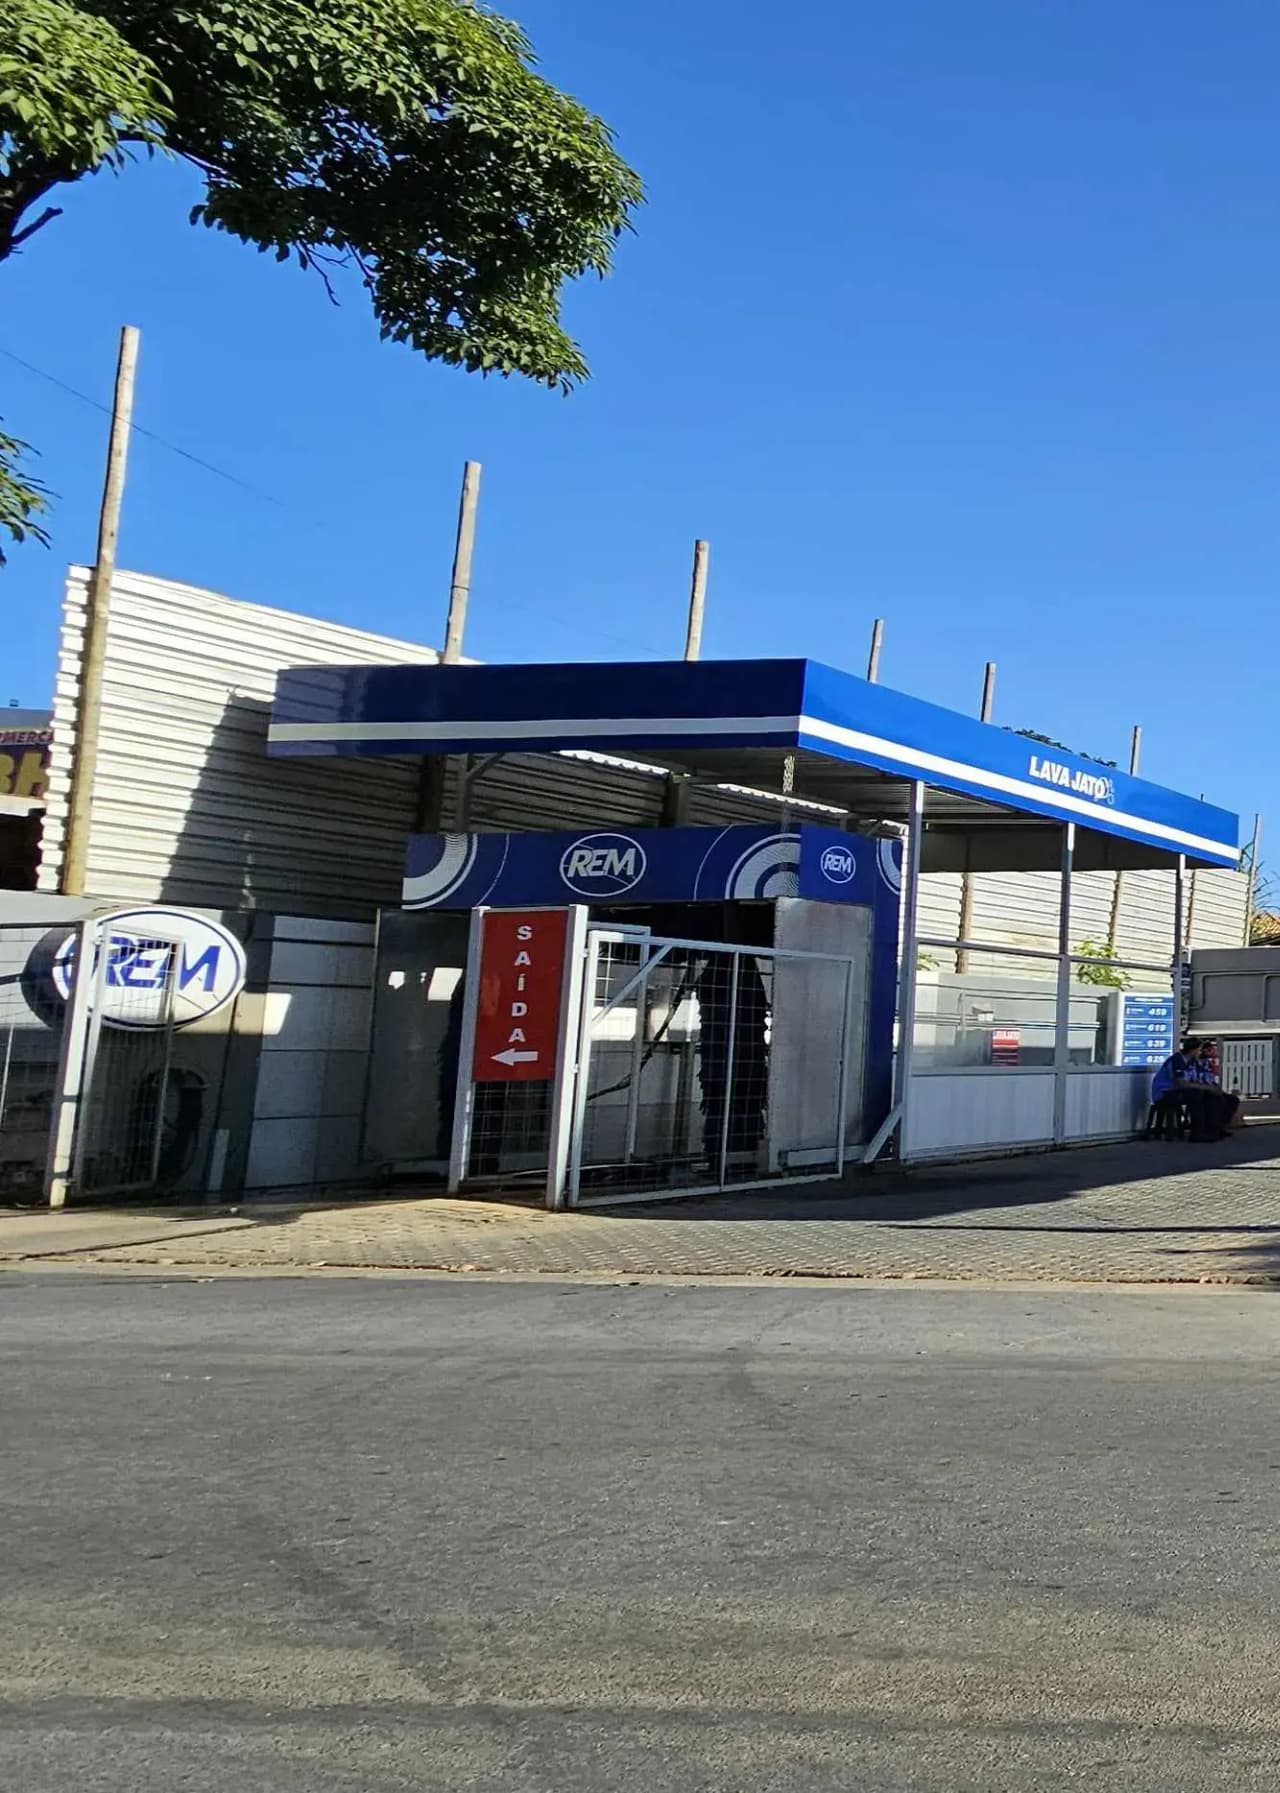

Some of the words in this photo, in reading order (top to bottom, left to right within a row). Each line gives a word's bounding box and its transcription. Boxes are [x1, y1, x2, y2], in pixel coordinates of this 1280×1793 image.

[1029, 755, 1070, 787] LAVA
[1071, 771, 1109, 799] JATO
[567, 848, 636, 878] REM
[824, 853, 852, 873] REM
[106, 936, 221, 992] REM
[508, 925, 533, 1042] SAÍDA
